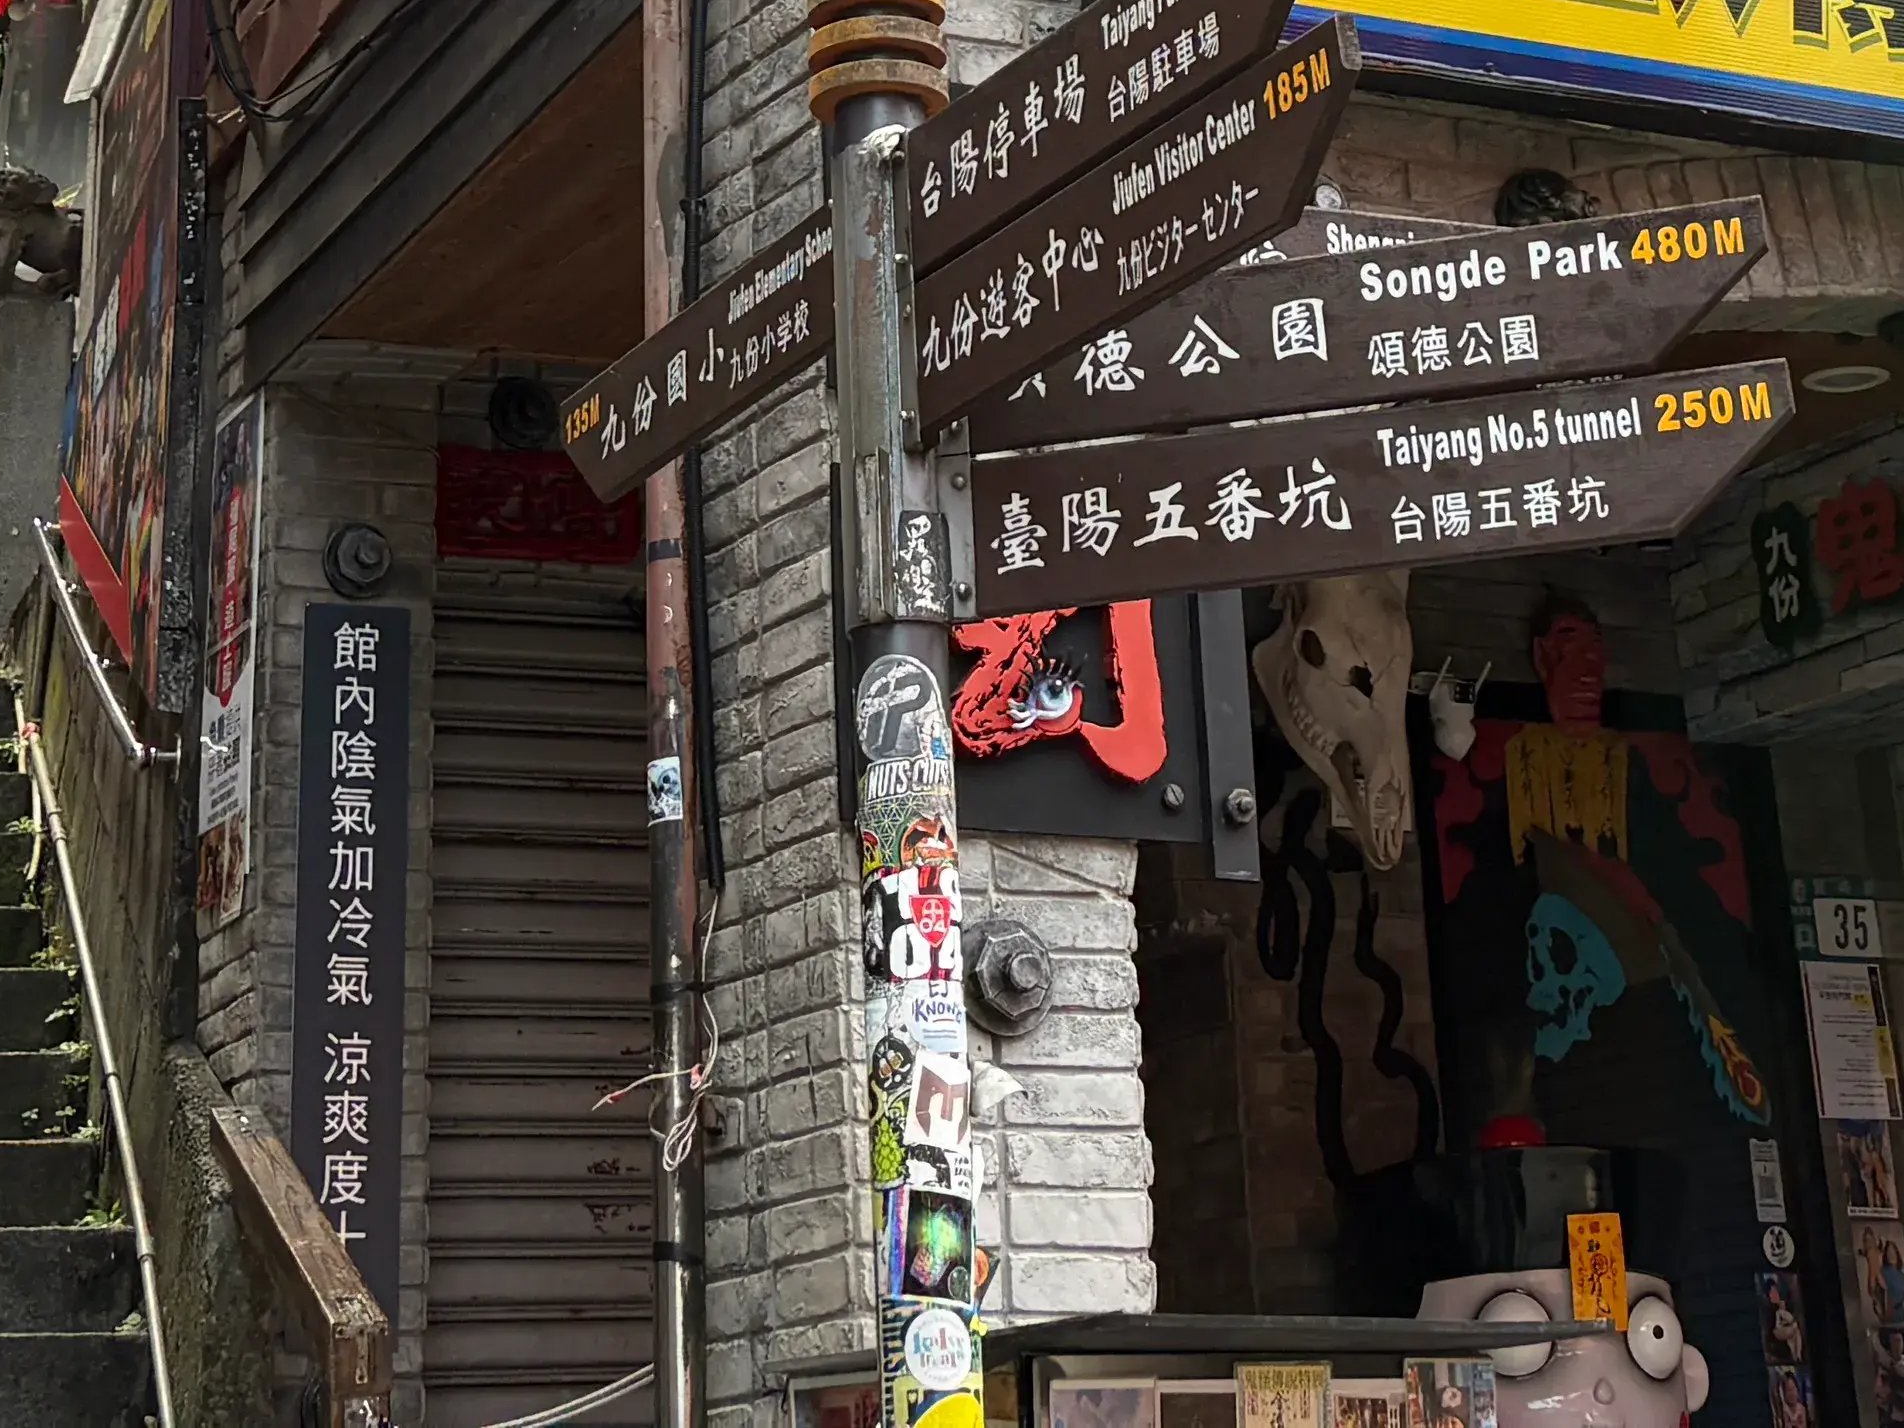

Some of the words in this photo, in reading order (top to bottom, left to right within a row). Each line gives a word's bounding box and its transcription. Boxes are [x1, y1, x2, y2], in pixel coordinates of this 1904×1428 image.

[1107, 11, 1221, 124] 台陽駐車場
[920, 55, 1088, 219] 台陽停車場
[1112, 160, 1157, 217] Jiufen
[1154, 130, 1206, 190] Visitor
[1205, 97, 1258, 156] Center
[1262, 47, 1332, 121] 185M
[922, 225, 1104, 380] 九份遊客中心
[1359, 249, 1507, 302] Songde
[1527, 232, 1623, 283] Park
[601, 328, 726, 461] 九份國小
[730, 297, 811, 391] 九份小学校
[1367, 314, 1540, 378] 頌德公園
[1377, 425, 1484, 474] Taiyang
[1487, 412, 1550, 456] No.5
[1553, 404, 1643, 449] tunnel
[990, 456, 1355, 579] 臺陽五番坑
[1390, 475, 1611, 545] 台陽五番坑
[1764, 524, 1801, 625] 九份
[327, 622, 381, 1008] 館內陰氣加冷氣
[1834, 903, 1870, 951] 35
